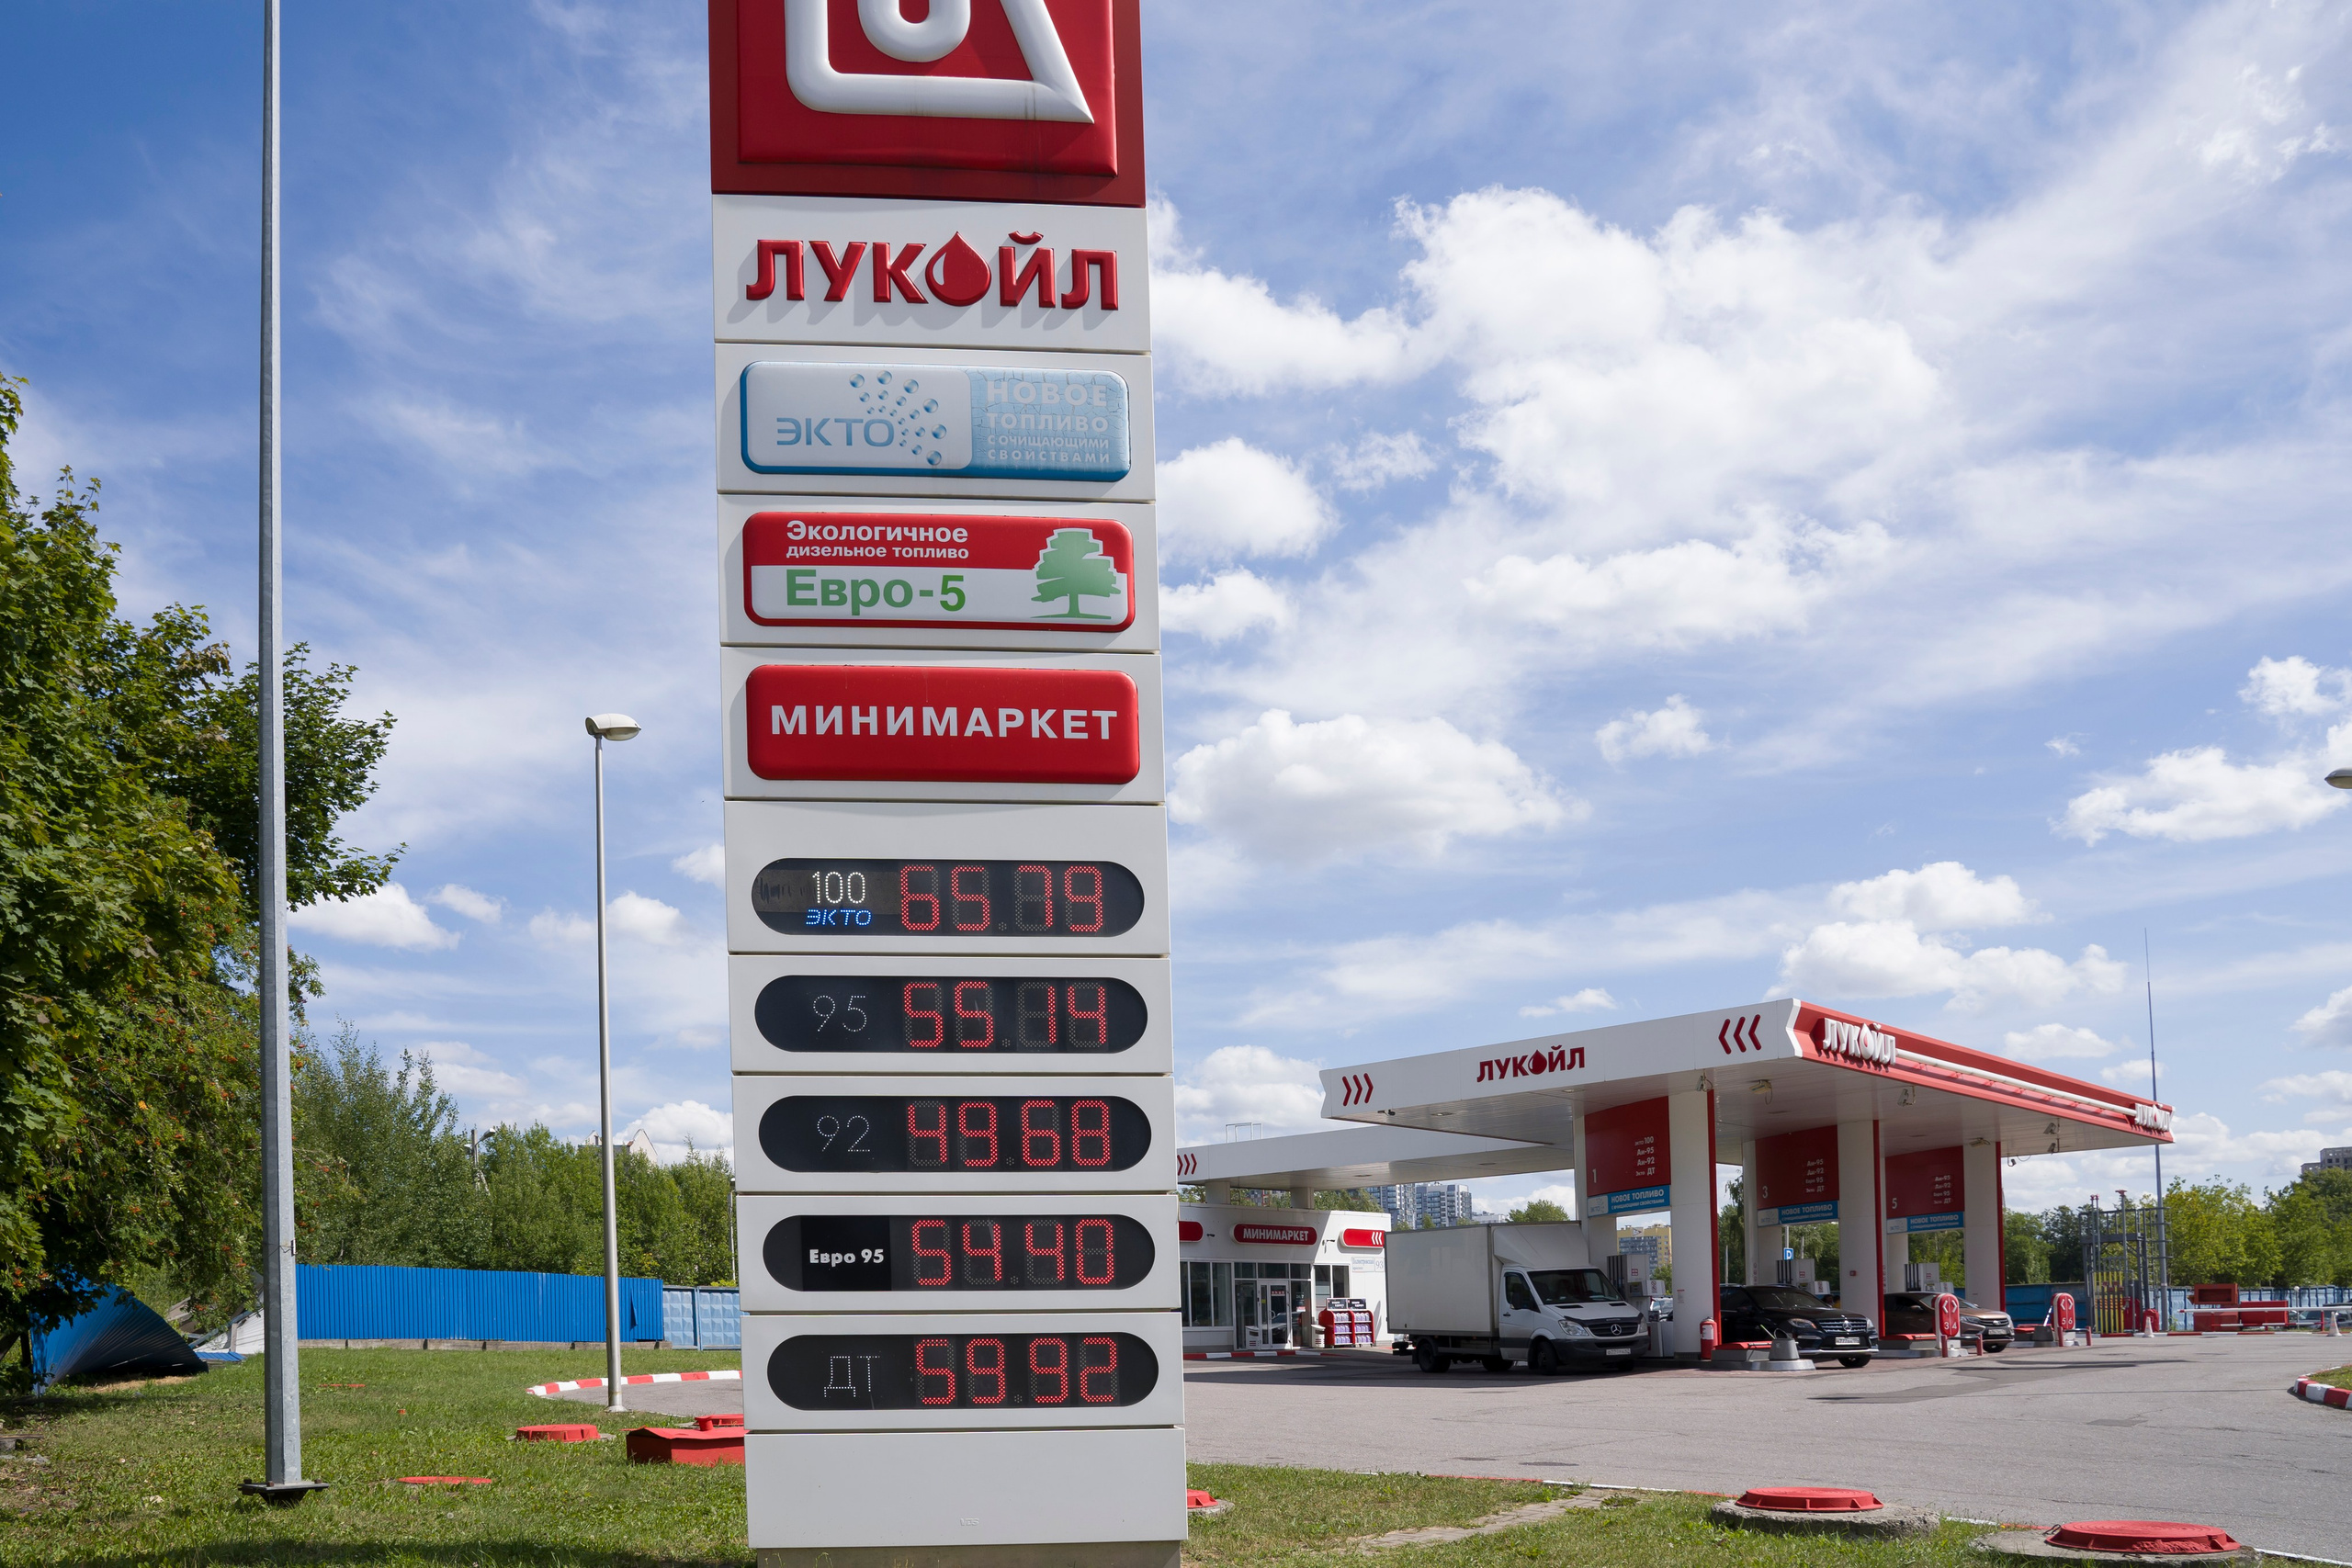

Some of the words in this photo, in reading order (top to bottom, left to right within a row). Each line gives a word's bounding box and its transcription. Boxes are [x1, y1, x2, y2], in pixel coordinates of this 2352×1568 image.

[745, 231, 1118, 310] ЛУКОЙЛ
[987, 381, 1107, 407] НОВОЕ
[776, 417, 895, 447] ЭКТО
[987, 412, 1109, 433] ТОПЛИВО
[999, 435, 1109, 449] ОЧИЩАЮЩИМИ
[988, 449, 1110, 463] СВОЙСТВАМИ
[786, 520, 968, 543] Экологичное
[786, 545, 887, 558] дизельное
[892, 547, 969, 559] топливо
[786, 569, 967, 615] Евро-5
[771, 705, 1117, 739] МИНИМАРКЕТ
[812, 871, 865, 904] 100
[805, 909, 872, 926] ЭКТО
[812, 995, 867, 1032] 95
[1823, 1017, 1895, 1066] ЛУКОЙЛ
[1476, 1045, 1585, 1082] ЛУКОЙЛ
[817, 1115, 871, 1152] 92
[1592, 1168, 1597, 1183] 1
[1611, 1193, 1630, 1203] НОВОЕ
[1632, 1190, 1664, 1201] ТОПЛИВО
[1762, 1186, 1768, 1198] 3
[1803, 1204, 1833, 1213] ТОПЛИВО
[1892, 1198, 1897, 1209] 5
[1243, 1228, 1308, 1241] МИНИМАРКЕТ
[809, 1248, 855, 1267] Евро
[861, 1248, 885, 1264] 95
[1944, 1322, 1949, 1330] 3
[824, 1356, 880, 1397] ДТ
